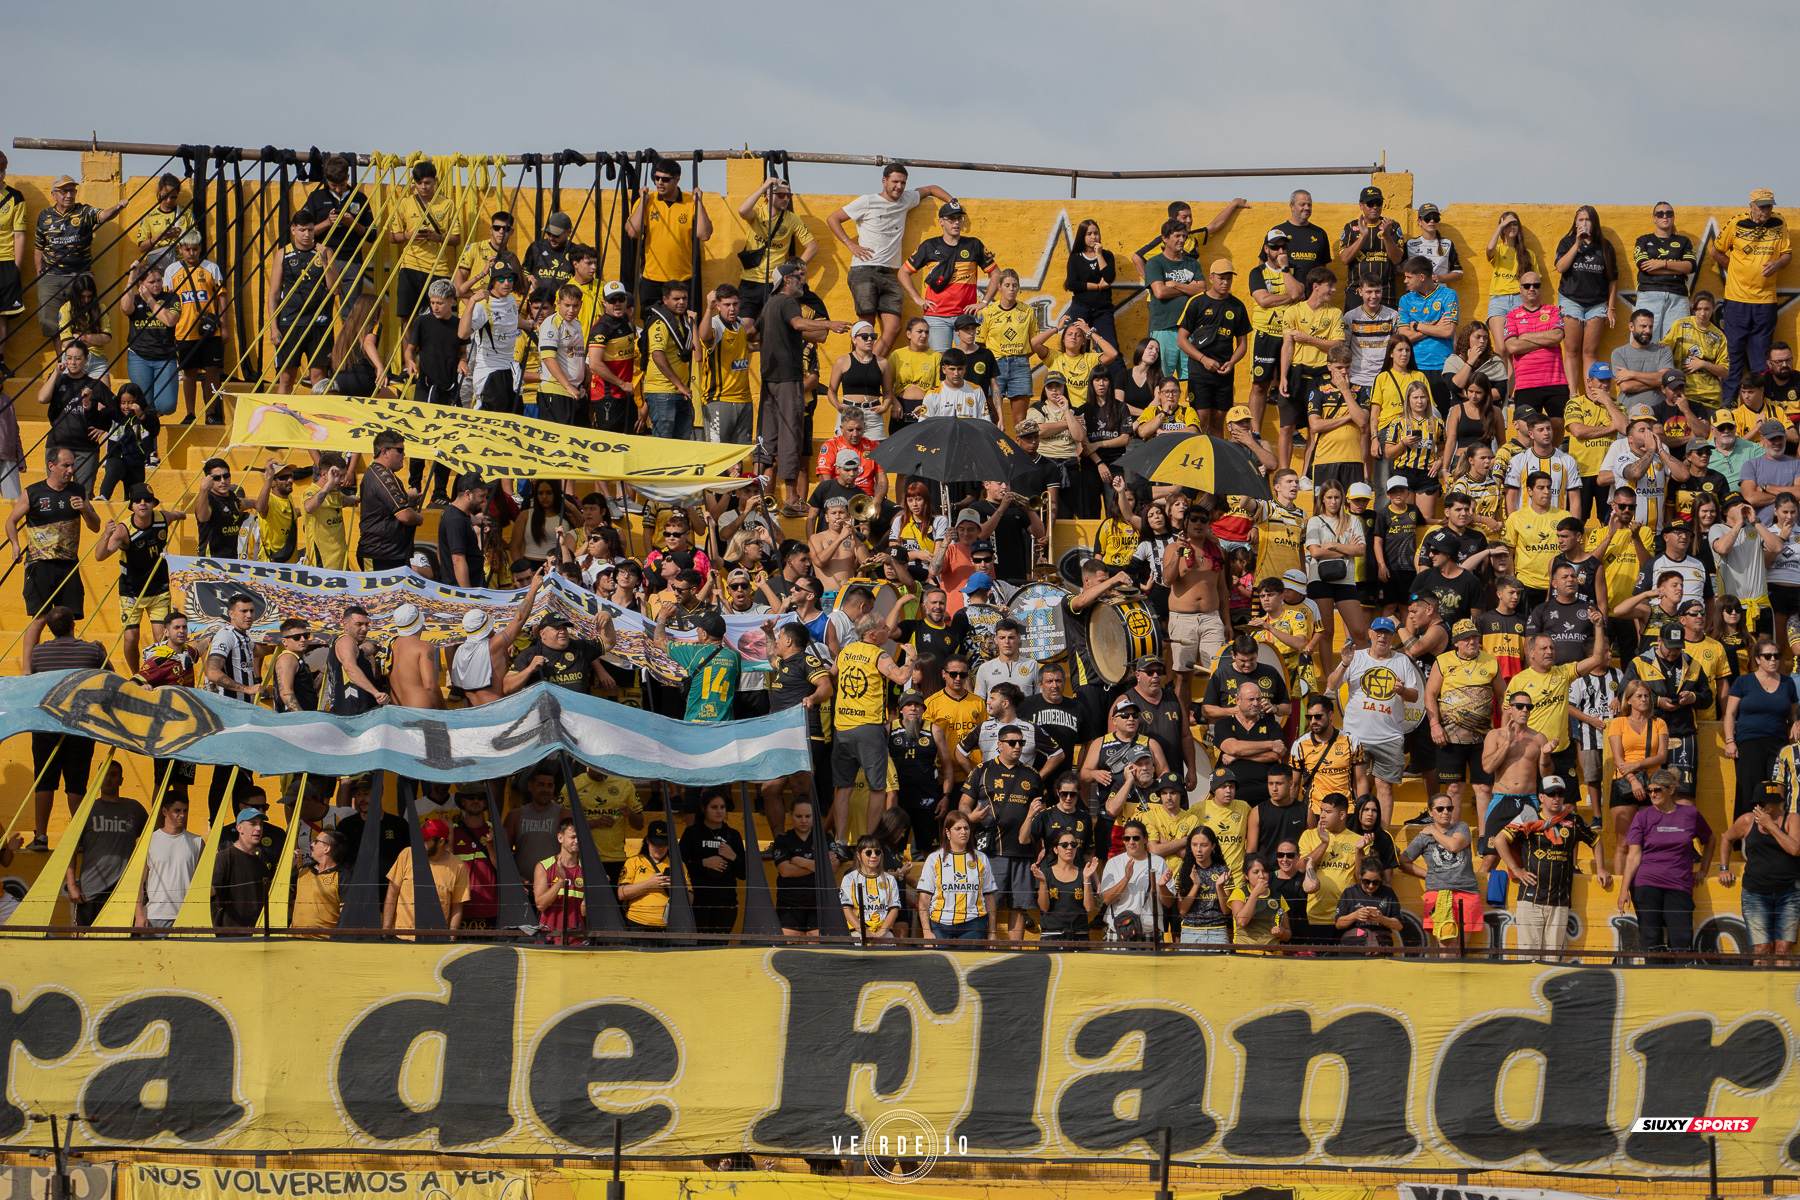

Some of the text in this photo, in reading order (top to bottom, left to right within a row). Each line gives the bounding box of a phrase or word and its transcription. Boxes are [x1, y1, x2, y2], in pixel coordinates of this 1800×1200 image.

[1290, 251, 1317, 260] CANARIO
[1573, 262, 1605, 272] CANARIO
[387, 401, 427, 419] LA
[433, 409, 561, 444] MUERTE
[566, 436, 631, 454] NOS
[1179, 453, 1205, 471] 14
[195, 558, 349, 589] Arriba
[701, 666, 730, 702] 14
[1165, 711, 1179, 721] 14
[1361, 701, 1393, 715] LA 14
[1032, 709, 1078, 733] LAUDERDALE
[1215, 834, 1243, 845] NARIO
[941, 882, 981, 892] CANARIO
[336, 946, 680, 1148] de
[750, 948, 1800, 1165] Flandr
[137, 1167, 201, 1189] NOS
[215, 1170, 405, 1196] VOLVEREMOS
[420, 1171, 441, 1190] A
